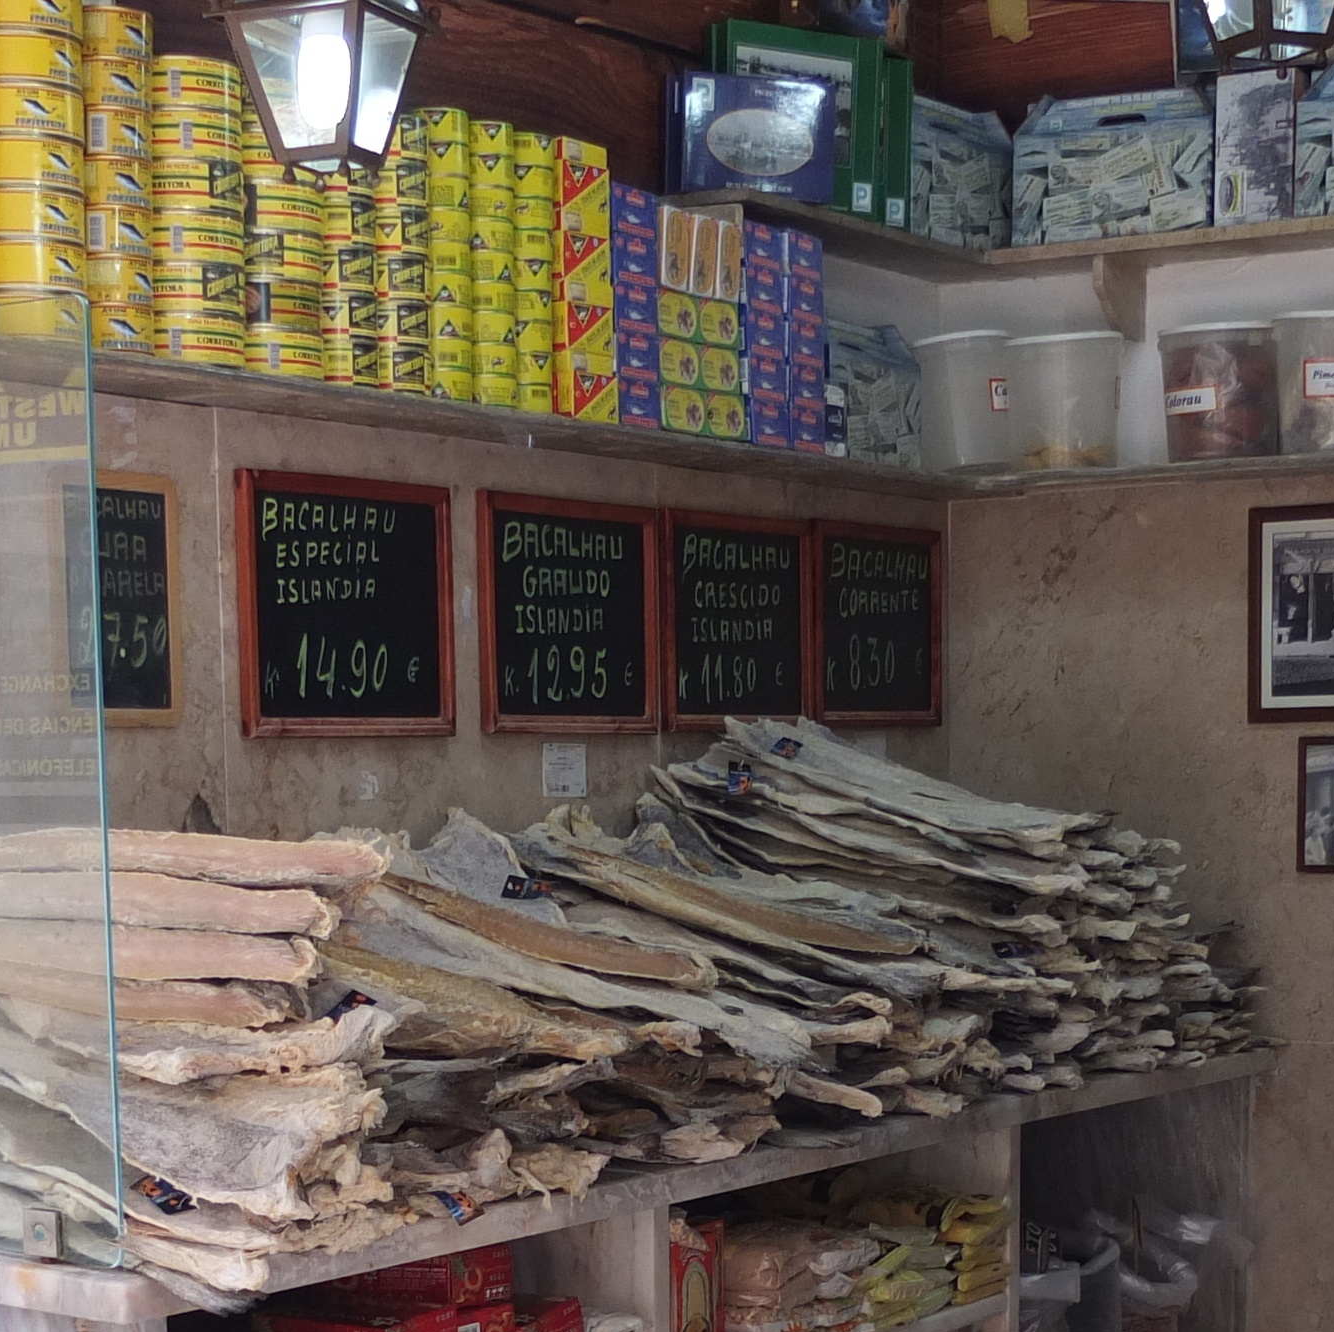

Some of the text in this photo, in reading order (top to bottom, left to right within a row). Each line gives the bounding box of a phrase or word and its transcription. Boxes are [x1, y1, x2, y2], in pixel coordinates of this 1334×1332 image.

[262, 496, 398, 542] BACALHAU
[274, 535, 382, 569] ESPECIAL
[501, 518, 625, 563] BACALHAU
[681, 532, 792, 580] BACALHAU
[828, 541, 931, 584] BACALHAU
[275, 574, 378, 605] ISLANDIA
[521, 563, 612, 600] GRAUDO
[693, 580, 782, 612] CRESCIDO
[513, 604, 606, 638] ISLANDIA
[837, 587, 921, 619] CORRENTE
[690, 616, 775, 645] ISLANDIA
[294, 630, 389, 699] 14.90
[406, 655, 421, 682] €
[526, 644, 610, 706] 12.95
[623, 660, 635, 688] €
[699, 653, 759, 704] 11.80
[773, 660, 786, 687] €
[913, 647, 925, 676] €
